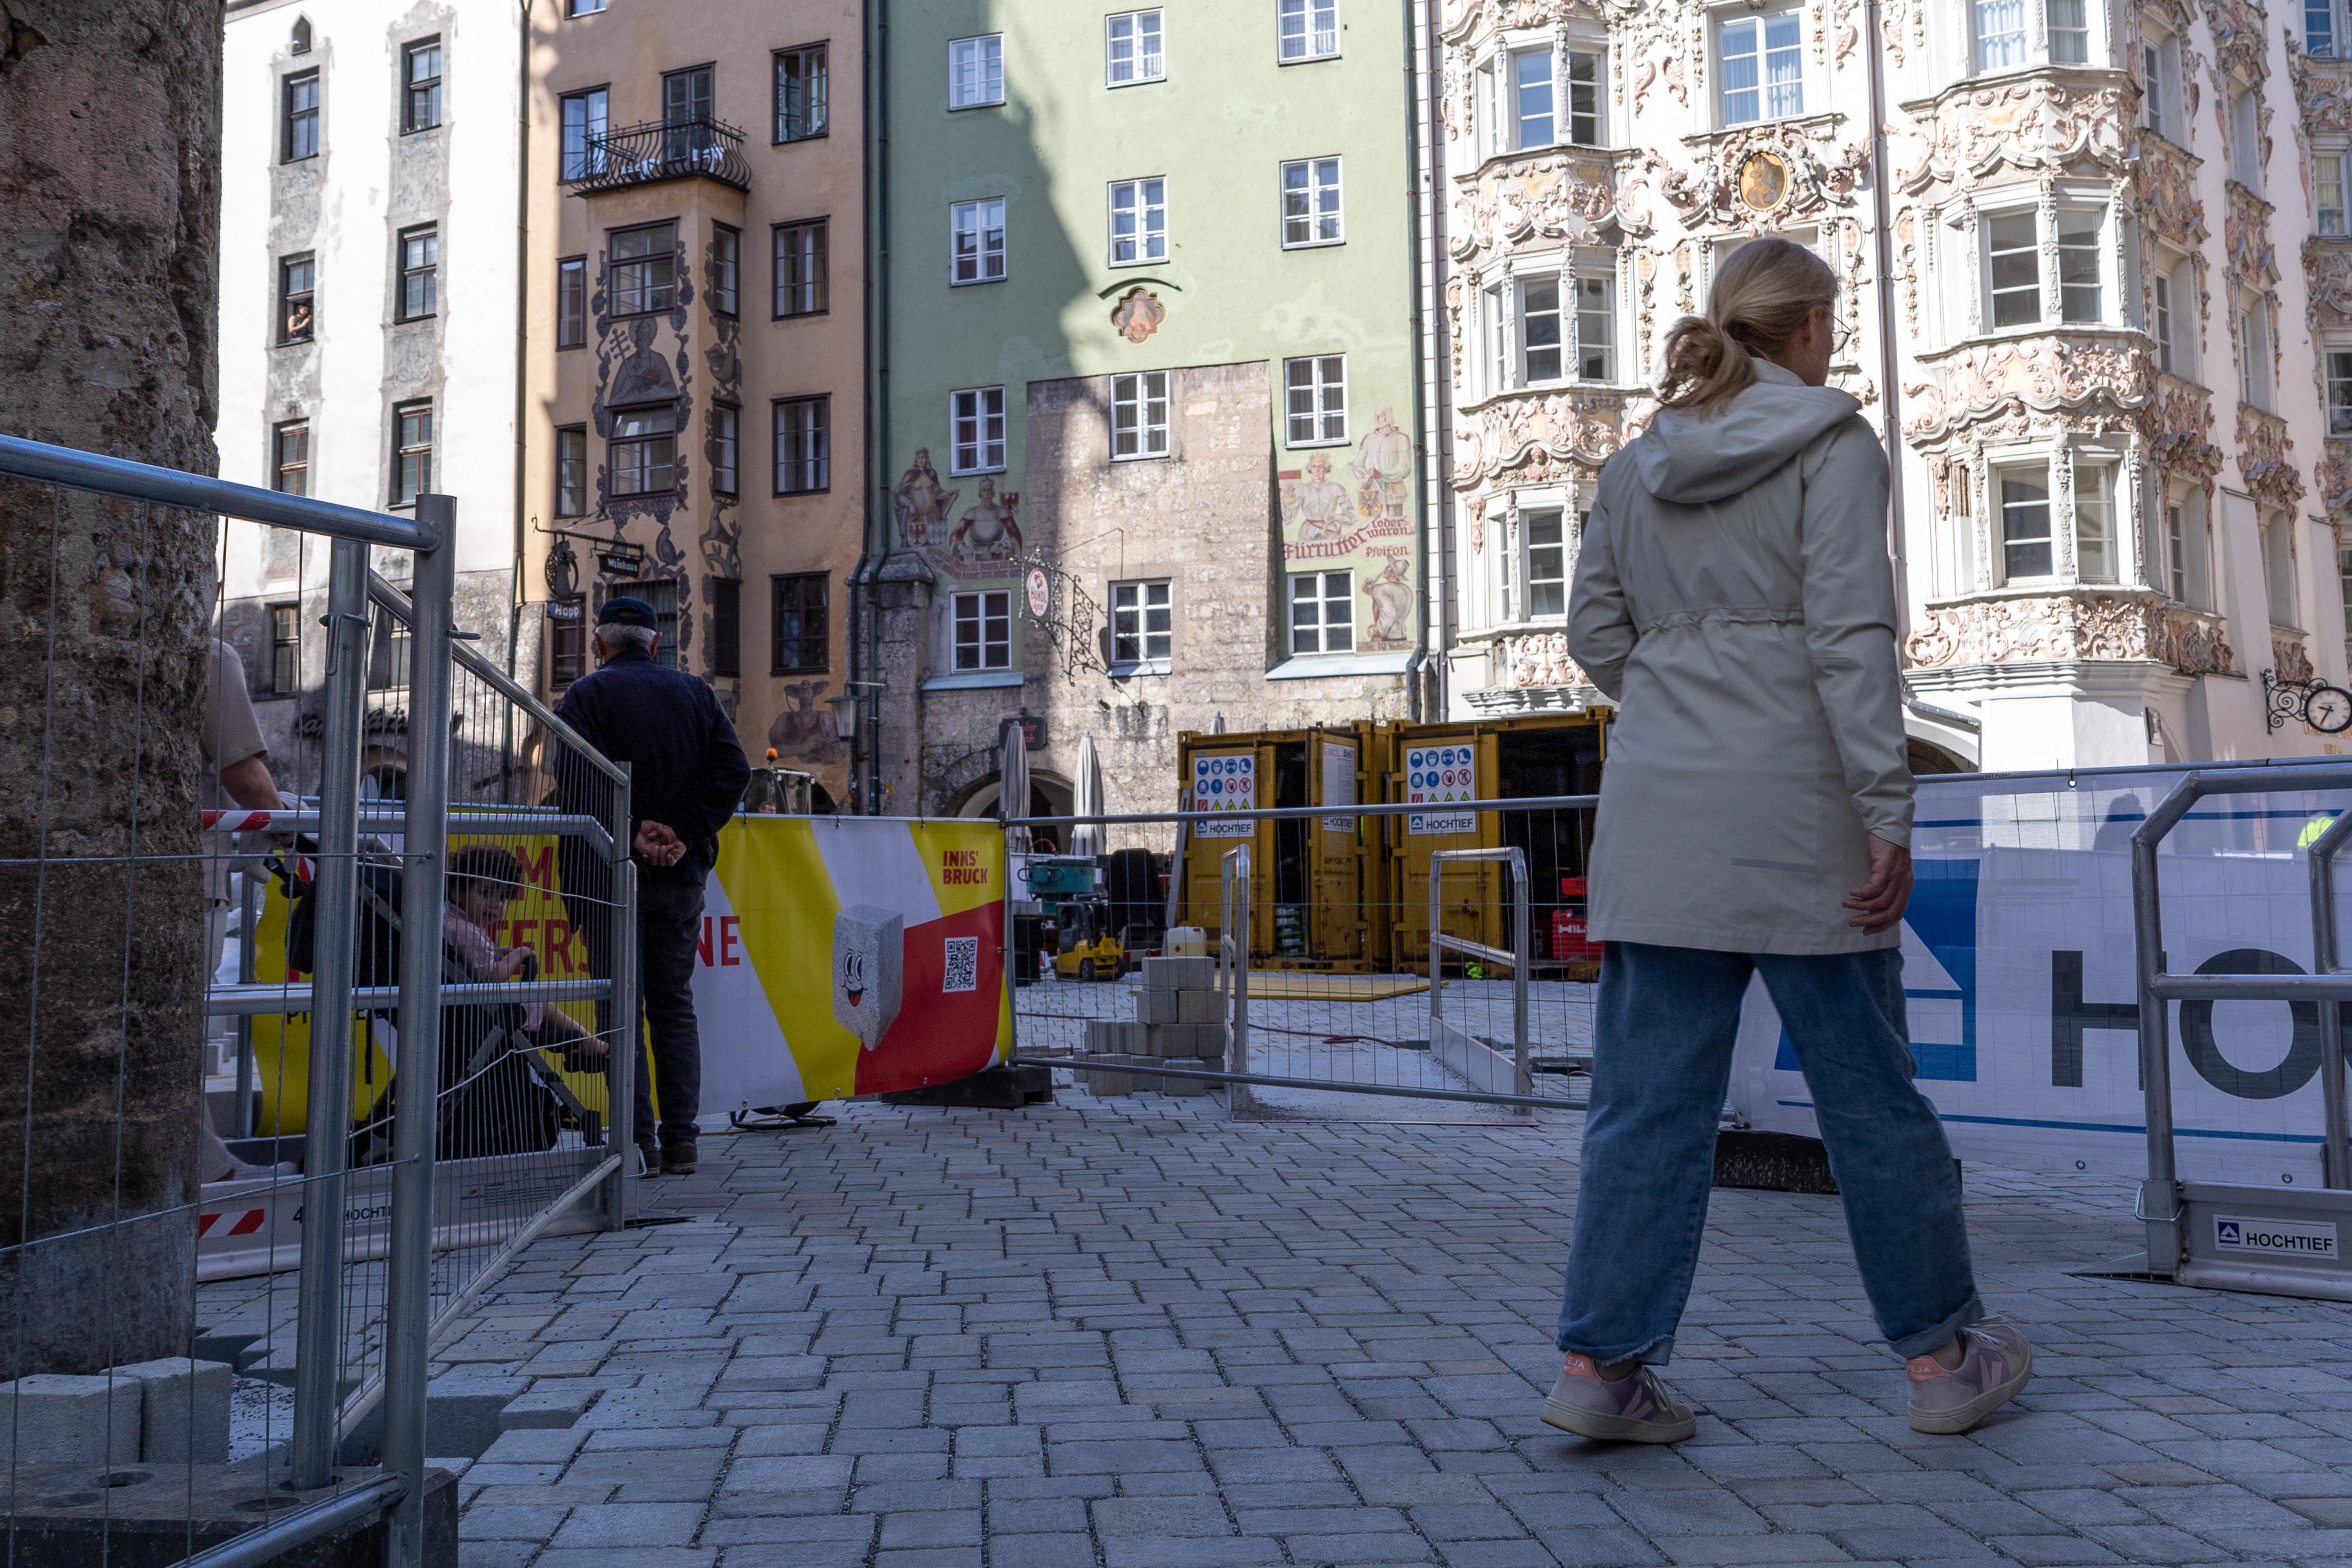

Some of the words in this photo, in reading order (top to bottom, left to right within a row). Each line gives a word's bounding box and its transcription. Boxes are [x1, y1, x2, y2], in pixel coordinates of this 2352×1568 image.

[607, 557, 638, 572] Weinhaus
[555, 604, 580, 618] Happ
[1210, 824, 1252, 833] HOCHTIEF
[1426, 818, 1473, 829] HOCHTIEF
[943, 868, 988, 885] BRUCK
[1558, 924, 1586, 934] HIL
[2052, 948, 2352, 1100] HO
[2246, 1232, 2334, 1251] HOCHTIEF
